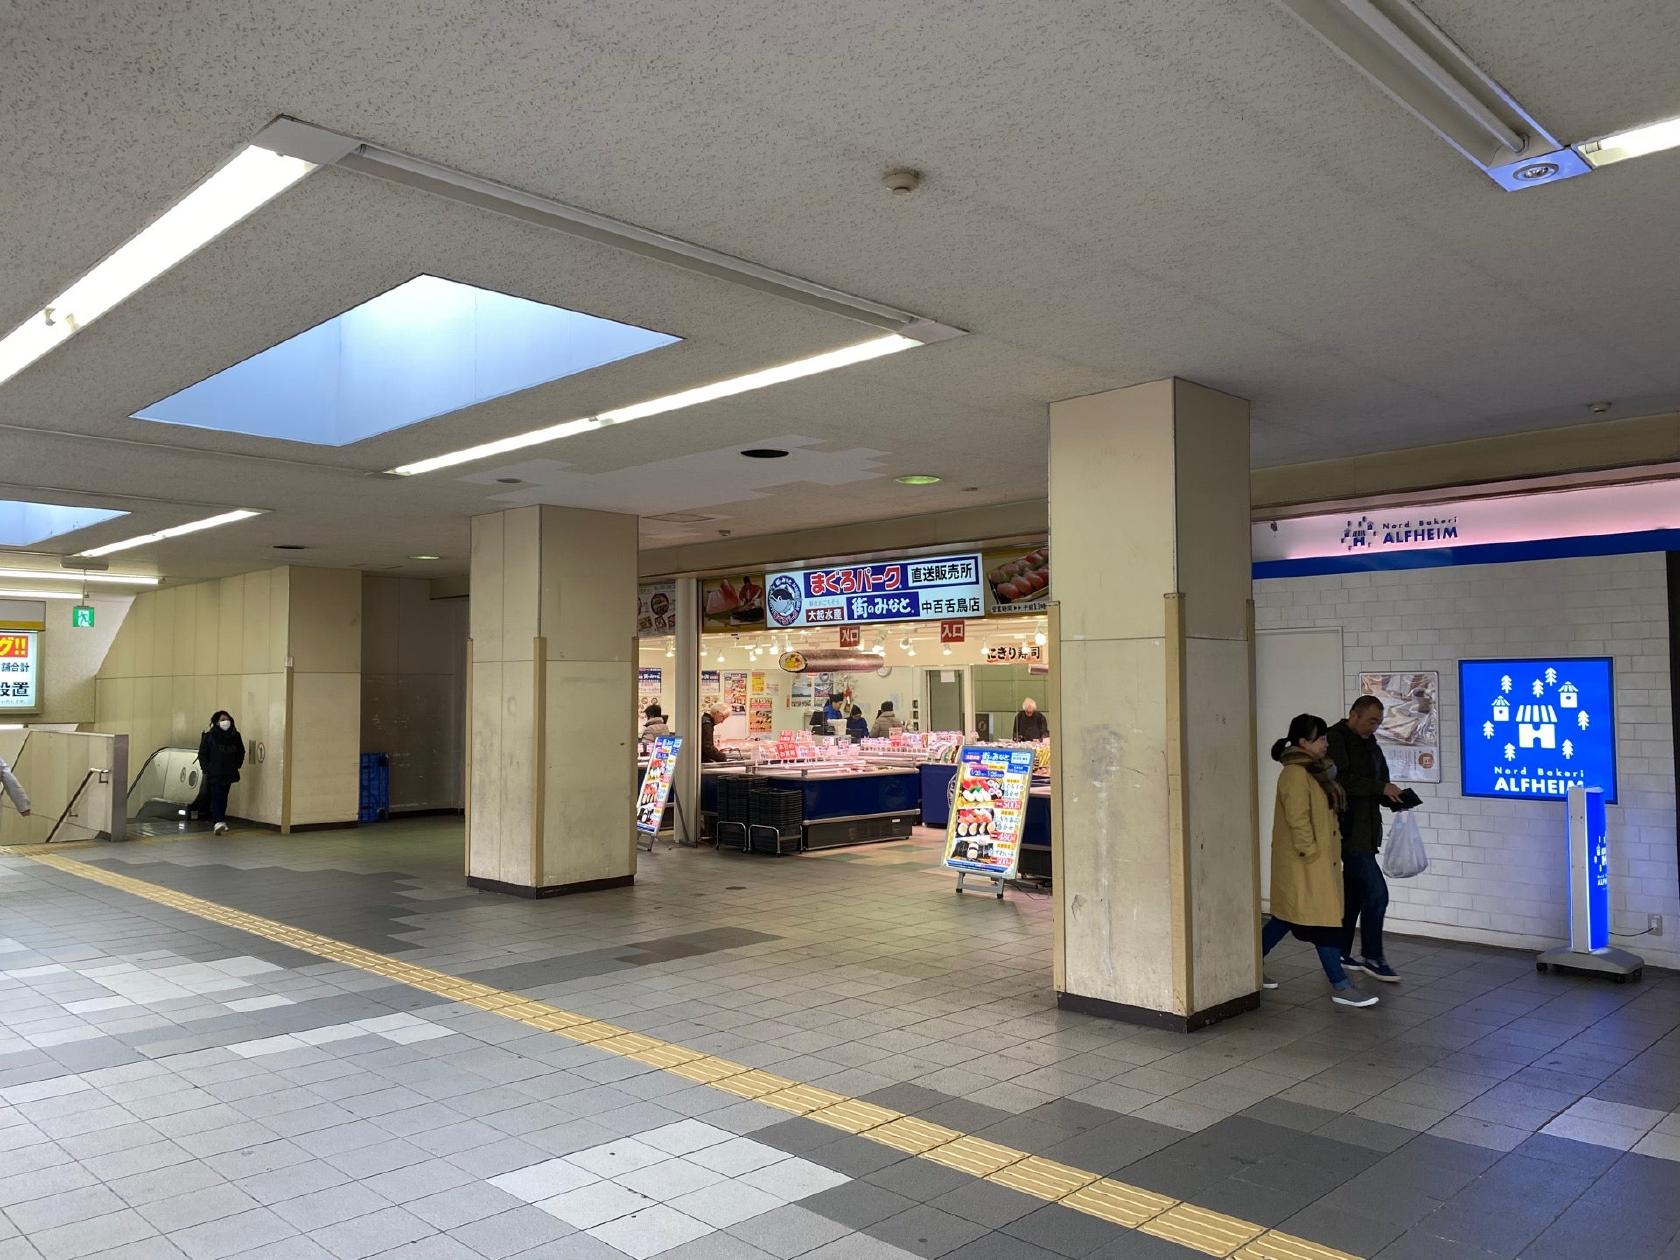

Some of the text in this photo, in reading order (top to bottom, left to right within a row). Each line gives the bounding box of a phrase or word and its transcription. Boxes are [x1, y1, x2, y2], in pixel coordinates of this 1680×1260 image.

[1382, 520, 1410, 530] Nord
[1382, 526, 1458, 544] ALFHEIM
[810, 564, 901, 595] まぐろパーク
[911, 562, 972, 584] 直送販売所
[852, 596, 911, 619] 街のみなと
[921, 597, 980, 615] 中百舌鳥店
[808, 608, 843, 621] 大起水産
[841, 628, 859, 642] 入口
[941, 624, 963, 638] 入口
[1494, 766, 1584, 778] Nord Bakeri
